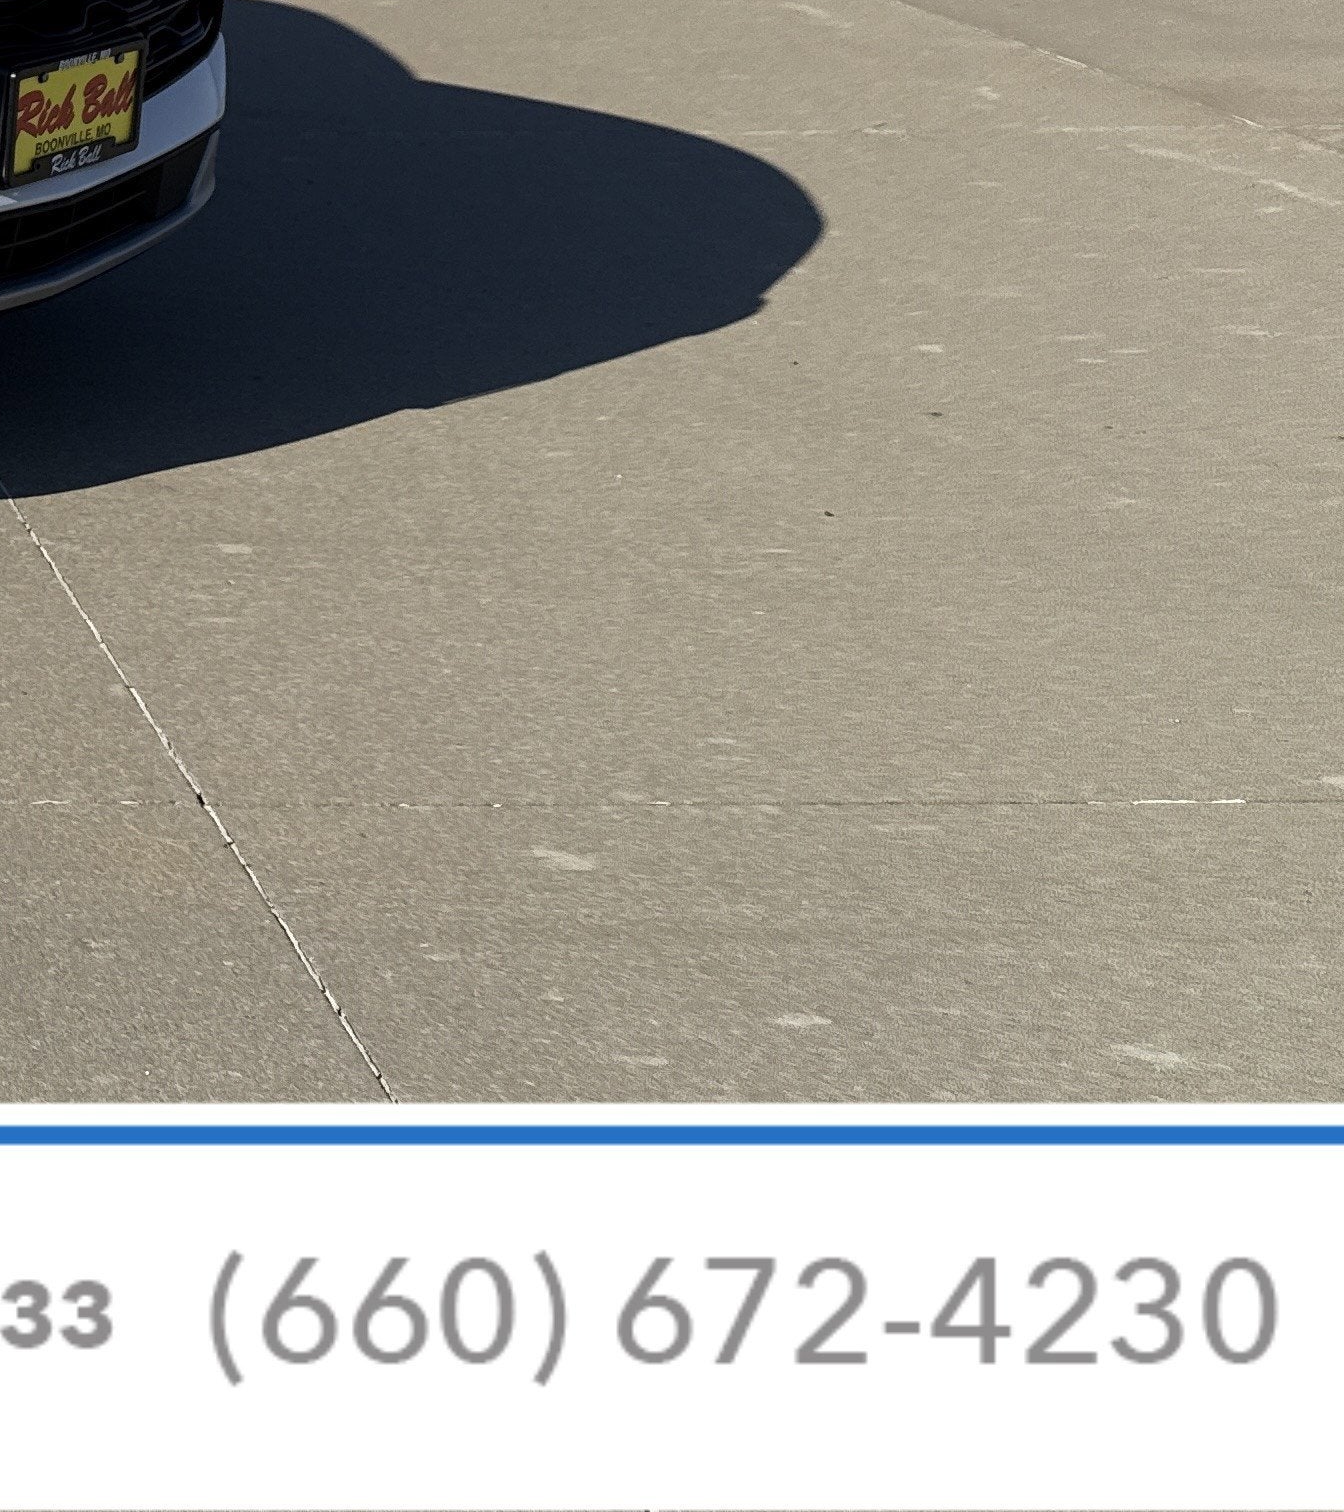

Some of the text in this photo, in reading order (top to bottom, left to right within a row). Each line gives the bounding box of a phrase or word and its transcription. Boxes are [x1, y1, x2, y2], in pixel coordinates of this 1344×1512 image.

[15, 68, 138, 138] Rick Ball
[95, 122, 112, 139] MO
[50, 144, 103, 176] Rick Ball
